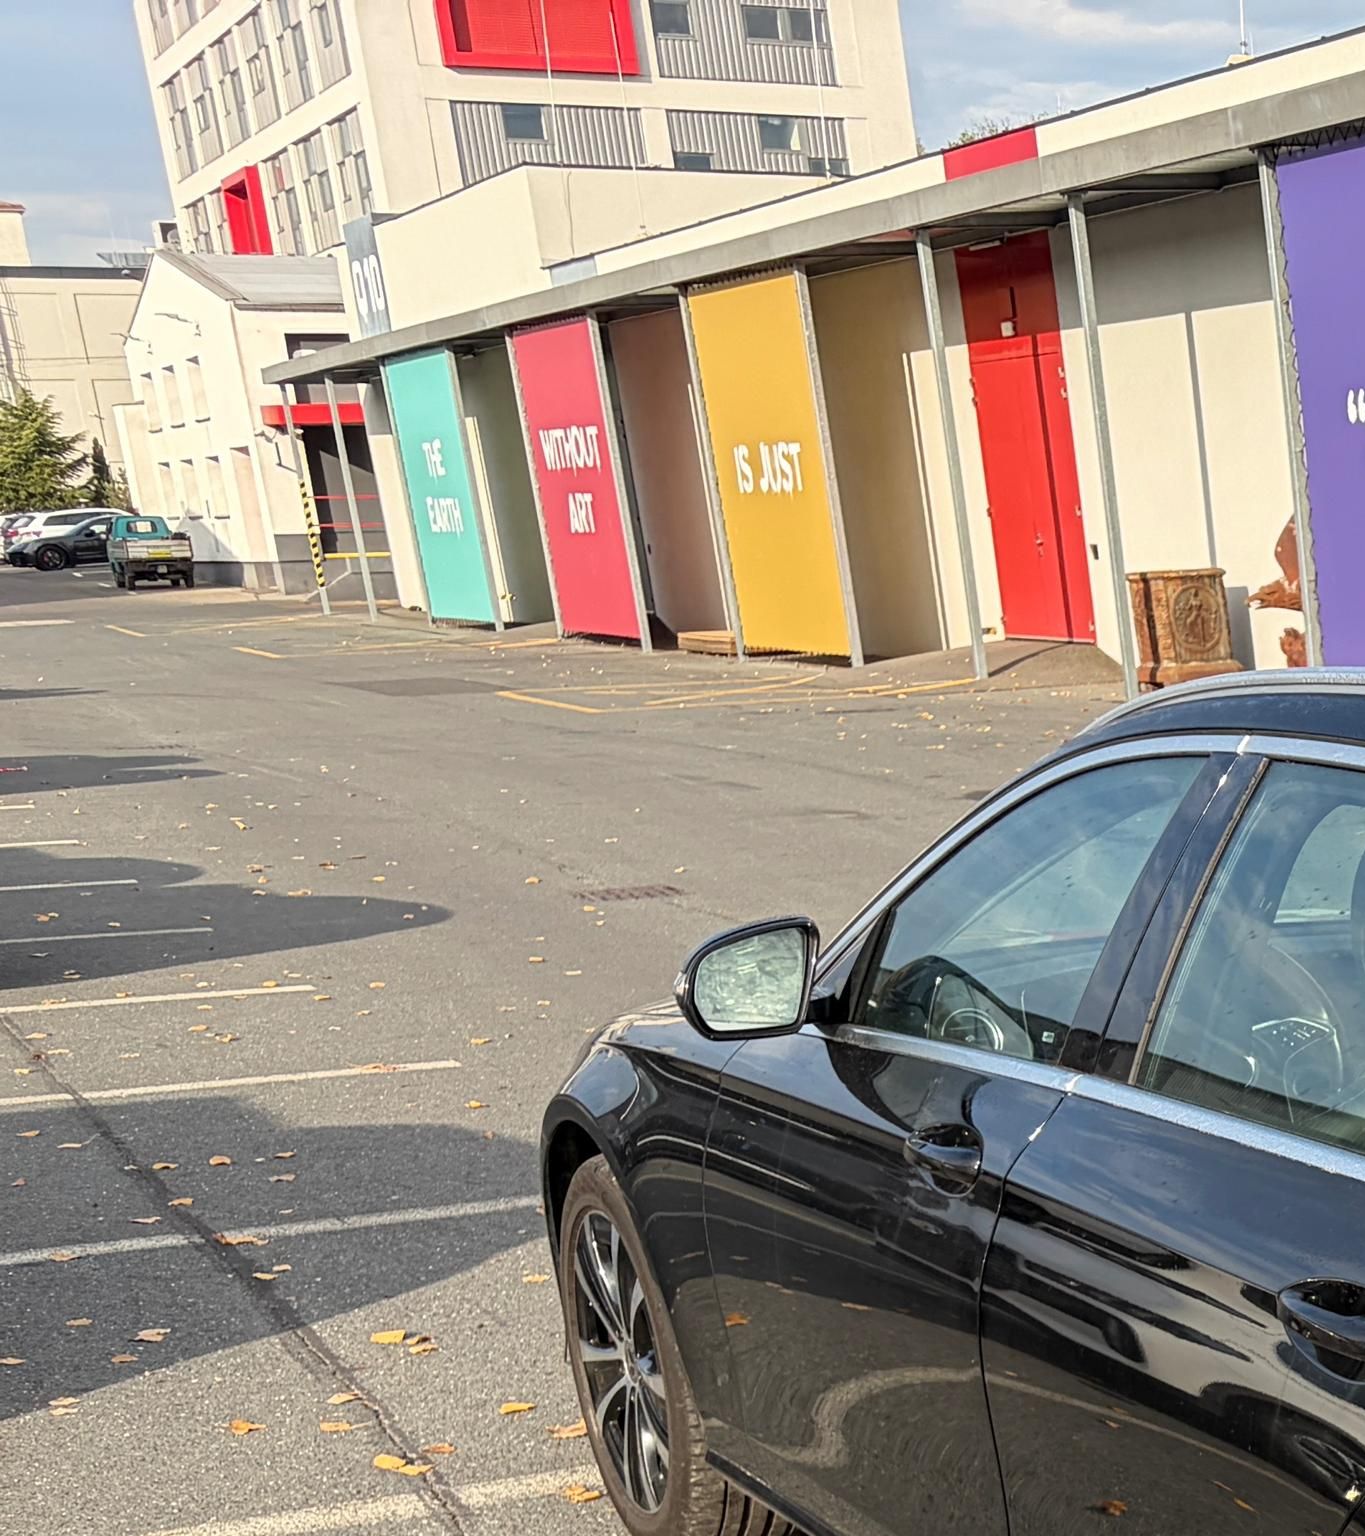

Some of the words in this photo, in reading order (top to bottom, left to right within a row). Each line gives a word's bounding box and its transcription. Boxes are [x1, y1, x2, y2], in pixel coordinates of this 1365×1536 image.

[352, 254, 386, 323] Q10
[421, 438, 446, 478] THE
[539, 425, 600, 473] WITHOUT
[733, 444, 754, 494] IS
[759, 441, 803, 498] JUST
[425, 496, 464, 535] EARTH
[568, 493, 596, 533] ART
